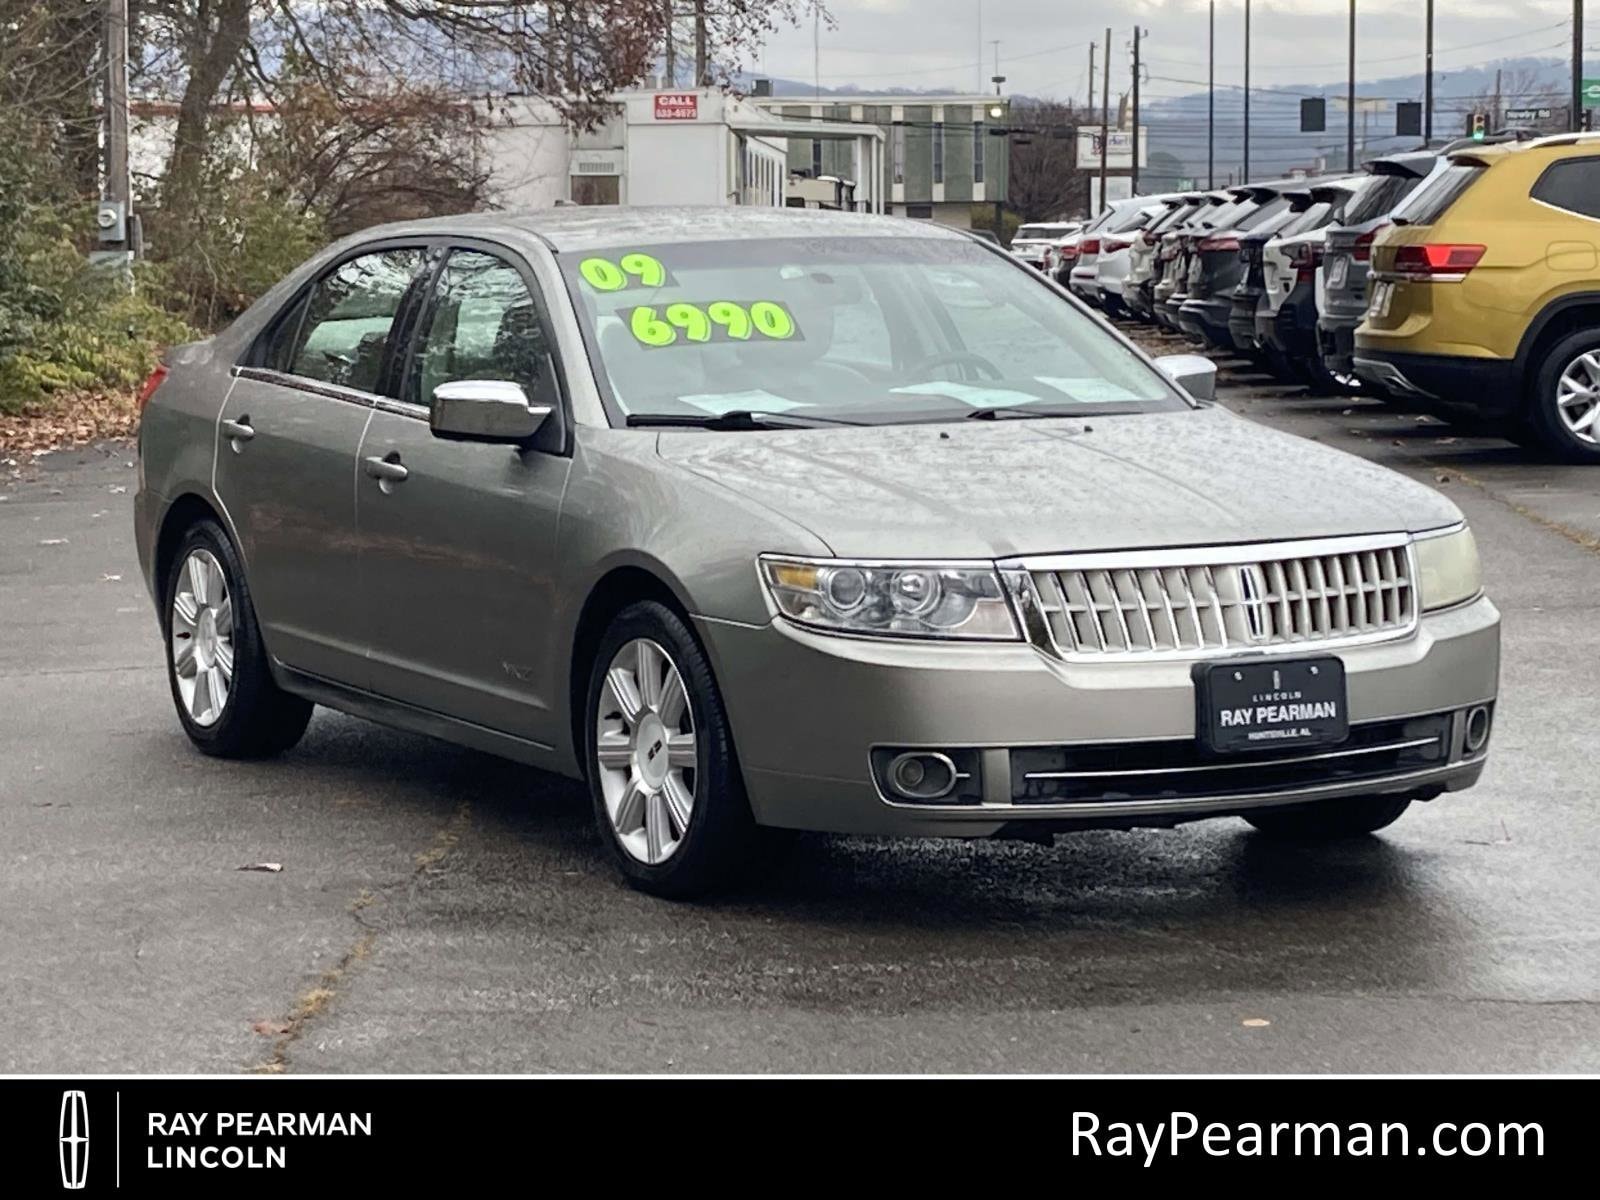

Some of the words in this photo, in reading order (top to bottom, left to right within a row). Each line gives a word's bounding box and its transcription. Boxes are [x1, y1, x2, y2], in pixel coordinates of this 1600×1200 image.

[658, 95, 694, 106] CALL
[579, 253, 666, 290] 09
[631, 301, 796, 346] 6990
[1253, 691, 1302, 702] LINCOLN
[1220, 707, 1253, 727] RAY
[1256, 701, 1336, 724] PEARMAN
[1301, 727, 1312, 737] AL
